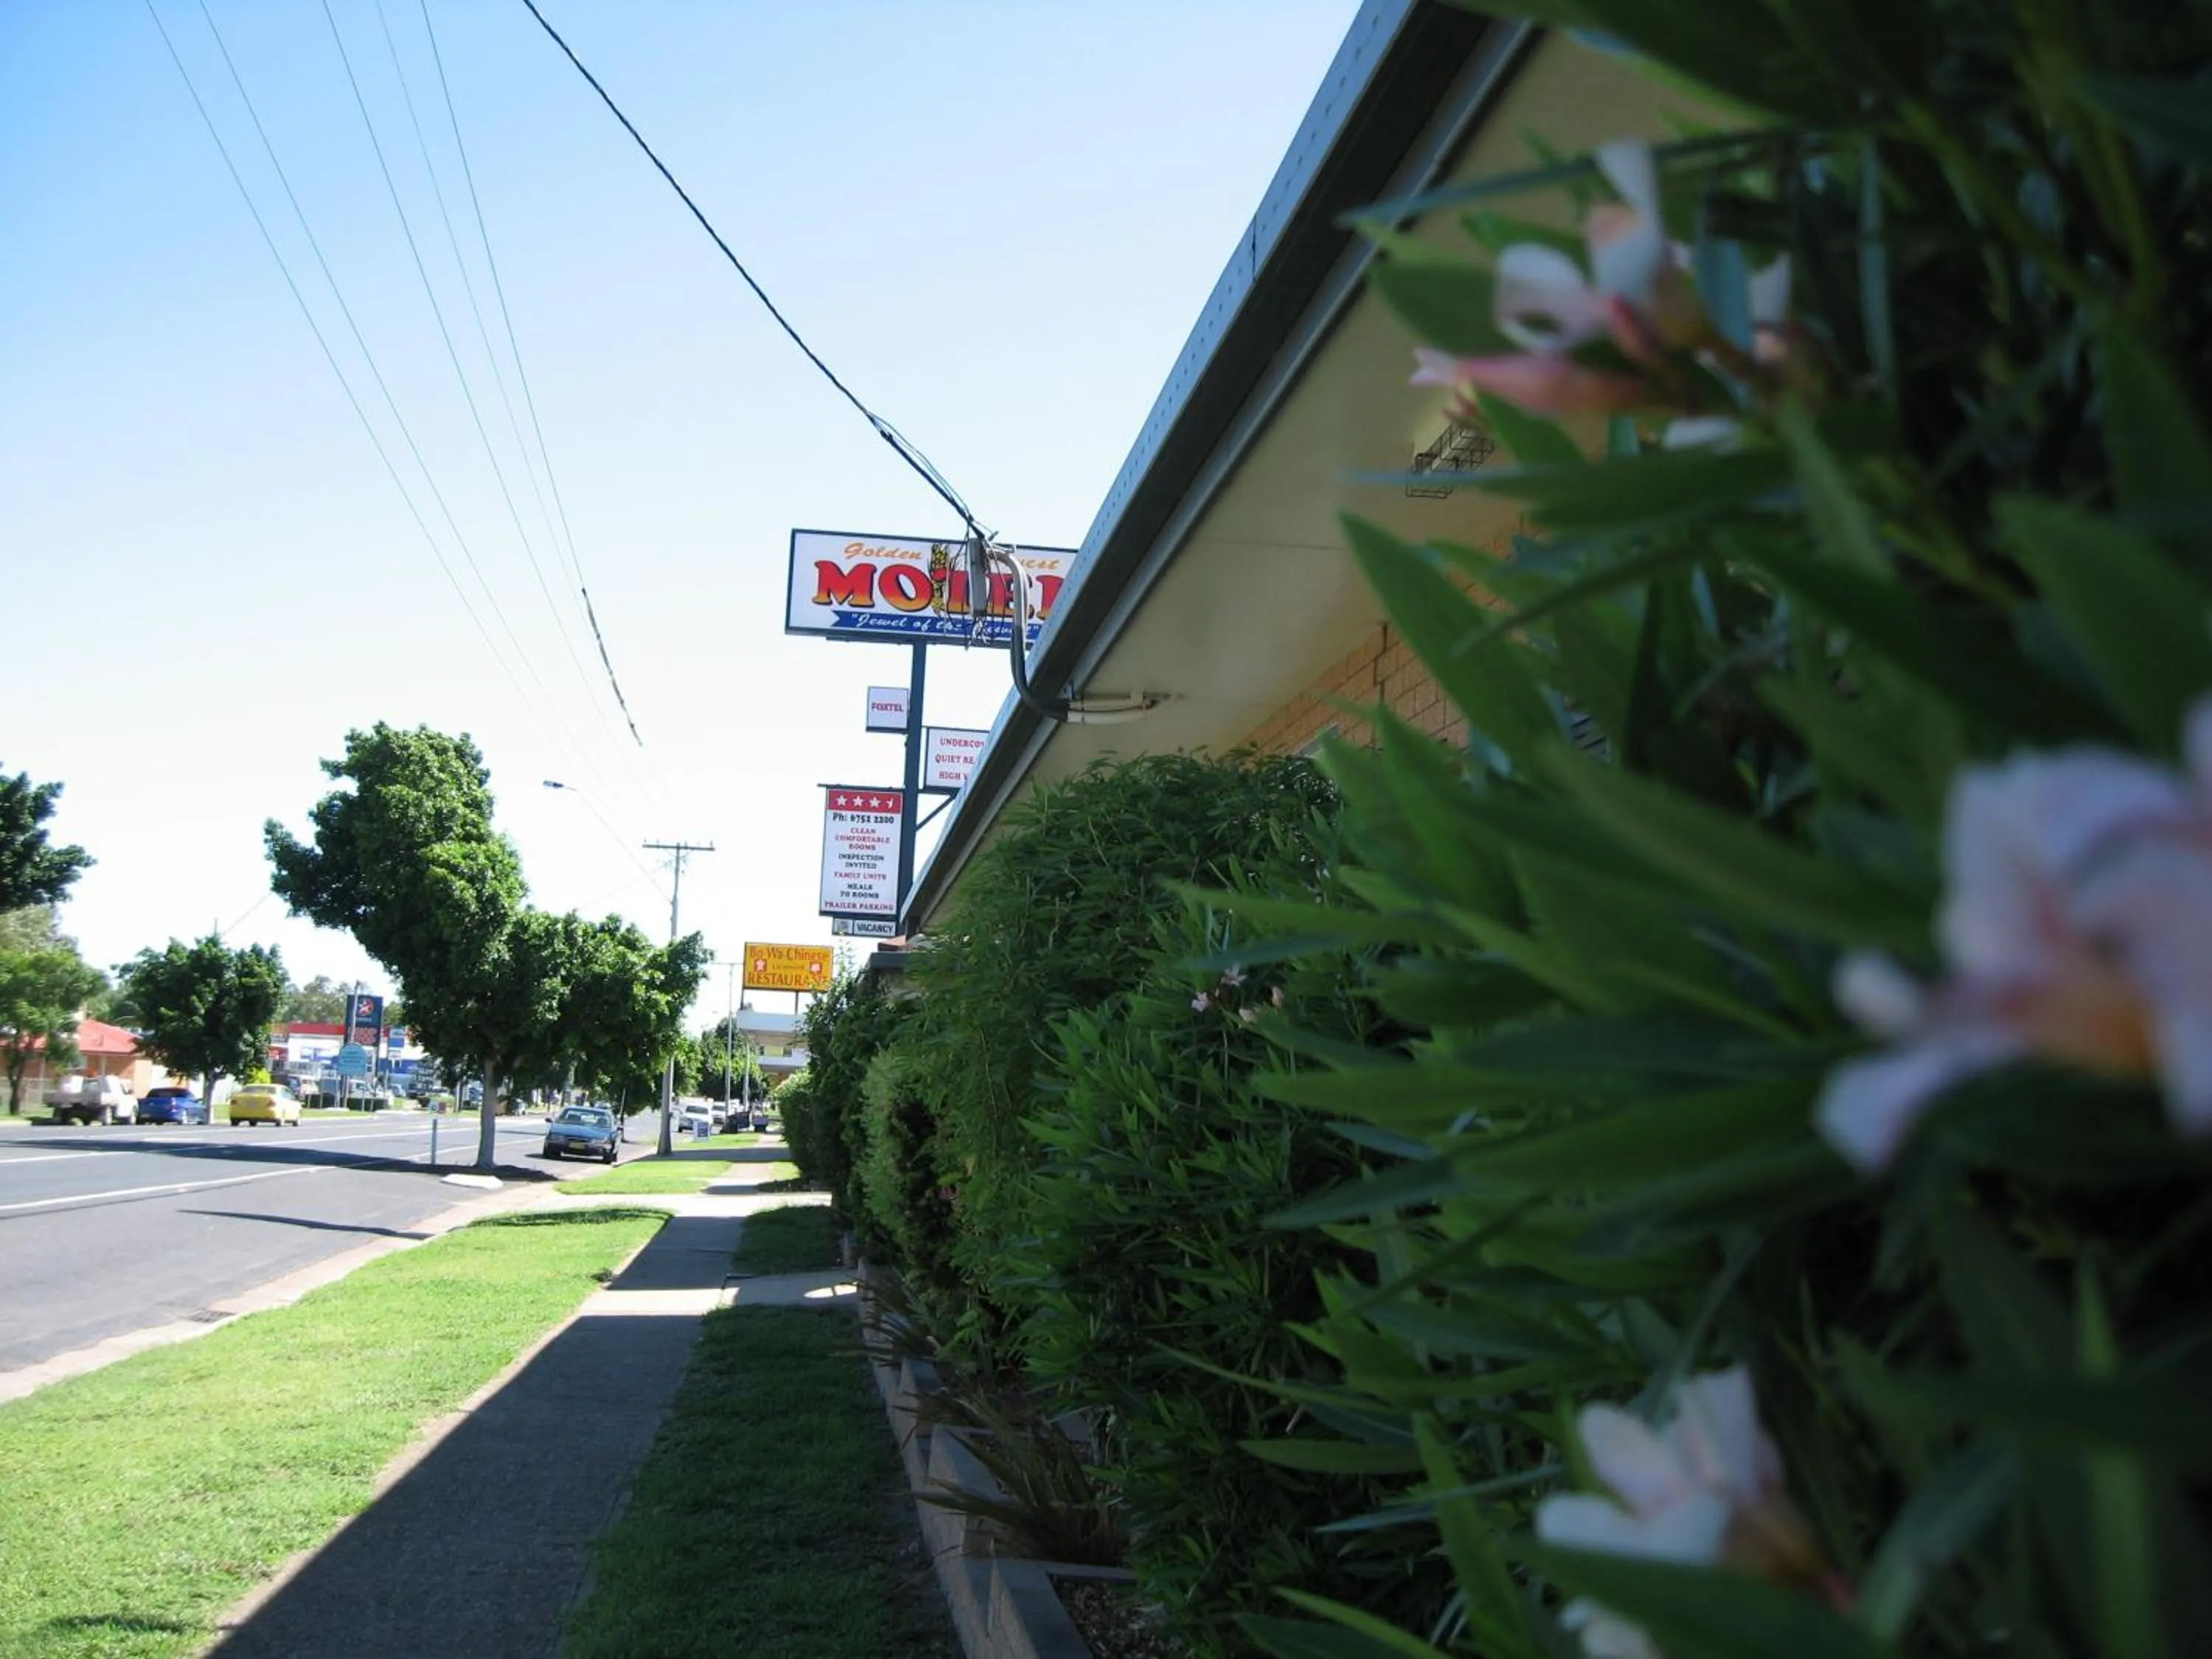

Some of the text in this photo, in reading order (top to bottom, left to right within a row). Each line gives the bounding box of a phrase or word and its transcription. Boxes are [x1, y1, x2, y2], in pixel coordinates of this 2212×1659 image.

[844, 542, 922, 560] Golden
[913, 619, 931, 631] of
[872, 703, 904, 712] FOXTEL
[935, 755, 960, 763] QUIET
[939, 771, 961, 780] HIGH
[832, 813, 847, 821] Ph:
[825, 901, 858, 909] TRAILER
[857, 923, 893, 933] VACANCY
[787, 947, 830, 961] Chinese
